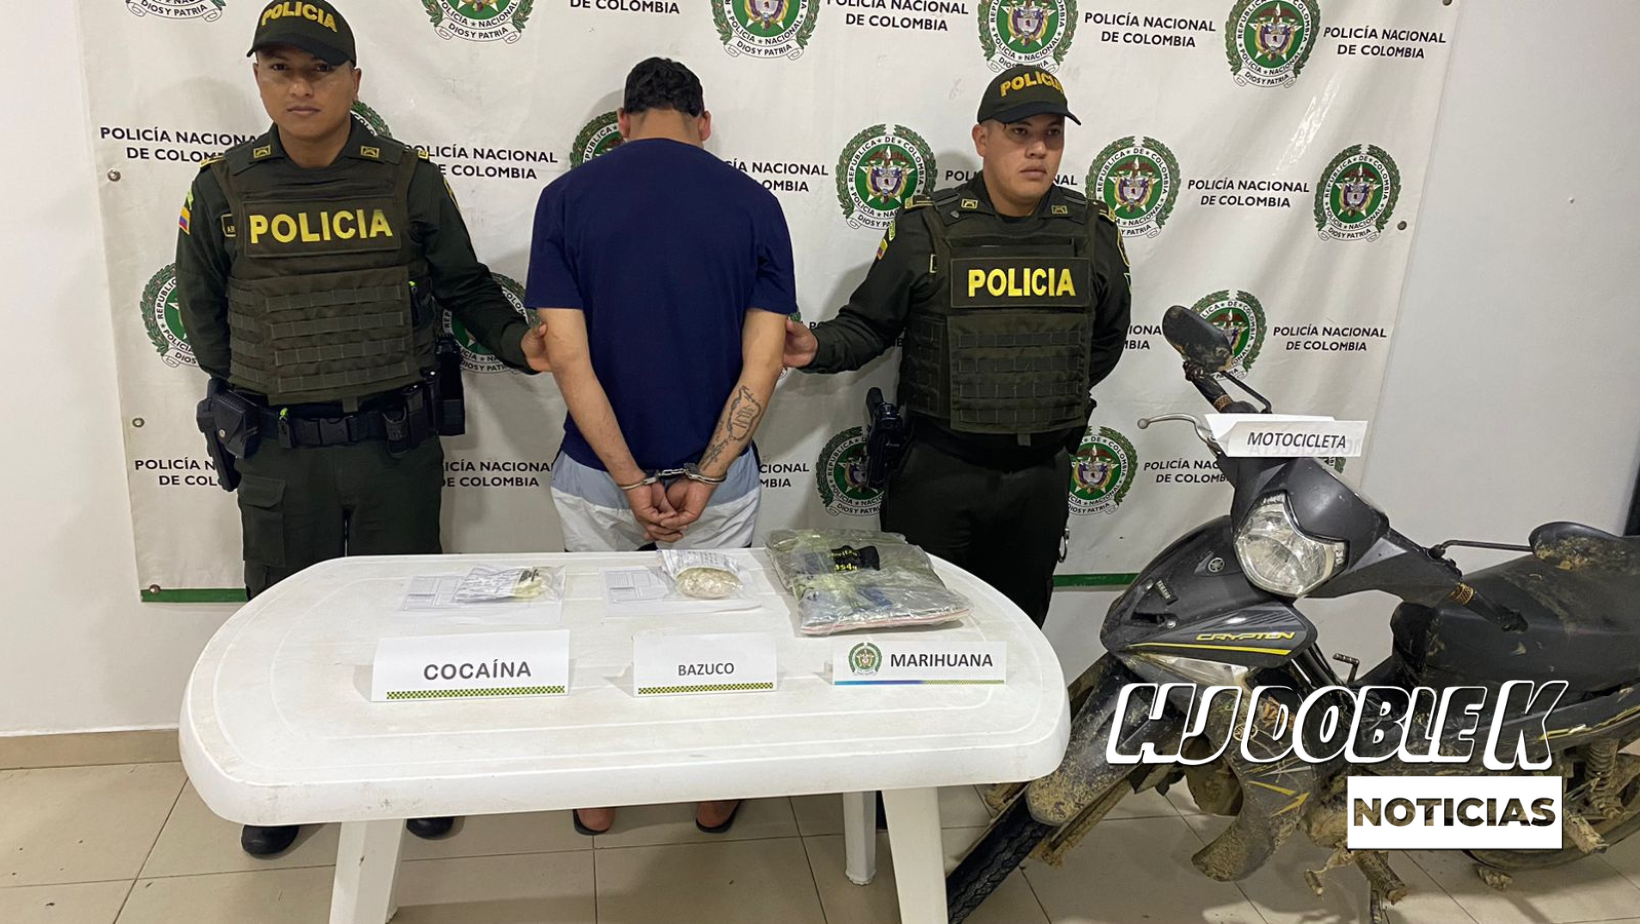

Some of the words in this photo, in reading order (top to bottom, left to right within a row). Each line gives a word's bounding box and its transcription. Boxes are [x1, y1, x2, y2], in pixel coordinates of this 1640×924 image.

[174, 4, 207, 16] PATRIA
[479, 1, 518, 28] NACIONAL
[570, 0, 591, 9] DE
[596, 0, 680, 14] COLOMBIA
[891, 0, 969, 15] NACIONAL
[261, 1, 338, 33] POLICIA
[846, 13, 865, 26] DE
[868, 15, 948, 31] COLOMBIA
[1084, 12, 1140, 27] POLICÍA
[1143, 16, 1217, 32] NACIONAL
[478, 27, 508, 39] PATRIA
[728, 16, 756, 42] POLICIA
[764, 19, 803, 45] NACIONAL
[1323, 25, 1379, 40] POLICÍA
[1381, 28, 1447, 43] NACIONAL
[1101, 31, 1119, 42] DE
[1122, 32, 1196, 47] COLOMBIA
[764, 44, 792, 56] PATRIA
[993, 33, 1016, 59] POLICIA
[1024, 37, 1060, 61] NACIONAL
[1337, 44, 1357, 55] DE
[1360, 44, 1425, 59] COLOMBIA
[1266, 74, 1290, 85] PATRIA
[100, 126, 171, 142] POLICÍA
[584, 127, 612, 159] PUBLICA
[126, 147, 150, 159] DE
[473, 148, 558, 163] NACIONAL
[752, 162, 829, 176] NACIONAL
[848, 140, 877, 183] REPUBLICA
[903, 142, 924, 186] COLOMBIA
[451, 164, 537, 180] COLOMBIA
[1097, 151, 1125, 192] REPUBLICA
[1151, 153, 1169, 194] COLOMBIA
[762, 180, 809, 192] OMBIA
[1188, 176, 1235, 190] POLICÍA
[1237, 180, 1310, 193] NACIONAL
[1373, 160, 1390, 200] COLOMBIA
[851, 192, 875, 216] POLICIA
[1200, 195, 1216, 205] DE
[1218, 195, 1291, 208] COLOMBIA
[1128, 203, 1163, 226] NACIONAL
[249, 209, 394, 244] POLICIA
[1126, 224, 1151, 235] PATRIA
[1346, 228, 1372, 239] PATRIA
[968, 267, 1077, 297] POLICIA
[156, 279, 177, 320] REPUBLIC
[1129, 325, 1162, 335] IONA
[1273, 324, 1319, 336] POLICÍA
[1322, 327, 1387, 338] NACIONAL
[1286, 341, 1301, 350] DE
[1303, 341, 1367, 351] COLOMBIA
[1247, 432, 1346, 449] MOTOCICLETA
[135, 456, 201, 470] POLICÍA
[828, 439, 854, 476] REPUBLICA
[1108, 441, 1127, 477] COLOMBIA
[1143, 457, 1190, 471] POLICÍA
[445, 459, 476, 472] ICÍA
[480, 461, 553, 472] NACIONA
[760, 463, 810, 474] CIONAL
[159, 475, 180, 485] DE
[460, 477, 540, 487] COLOMBIA
[1156, 474, 1172, 483] DE
[1175, 474, 1227, 483] COLOMB
[831, 484, 853, 505] POLICIA
[1087, 502, 1110, 514] PATRIA
[1196, 631, 1297, 642] CRYPTON
[890, 653, 993, 667] MARIHUANA
[423, 658, 532, 681] COCAÍNA
[677, 662, 735, 678] BAZUCO
